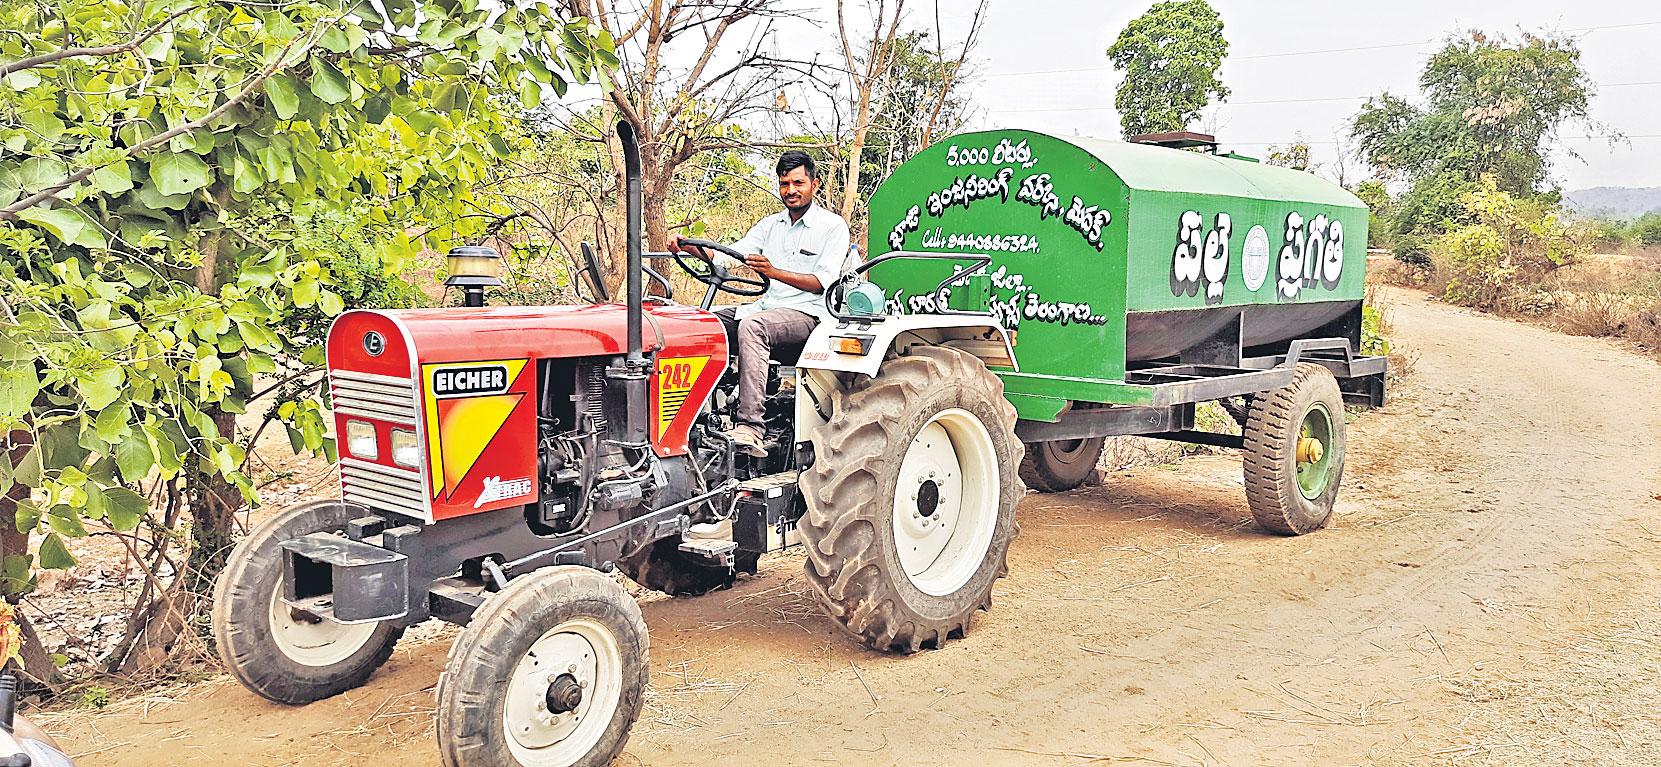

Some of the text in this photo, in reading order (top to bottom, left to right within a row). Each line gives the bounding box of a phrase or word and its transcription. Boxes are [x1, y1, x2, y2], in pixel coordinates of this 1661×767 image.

[946, 144, 988, 167] 5,000
[1170, 210, 1232, 304] పల్లె
[1276, 211, 1344, 303] ప్రగతి
[436, 370, 504, 391] EICHER
[662, 363, 691, 389] 242
